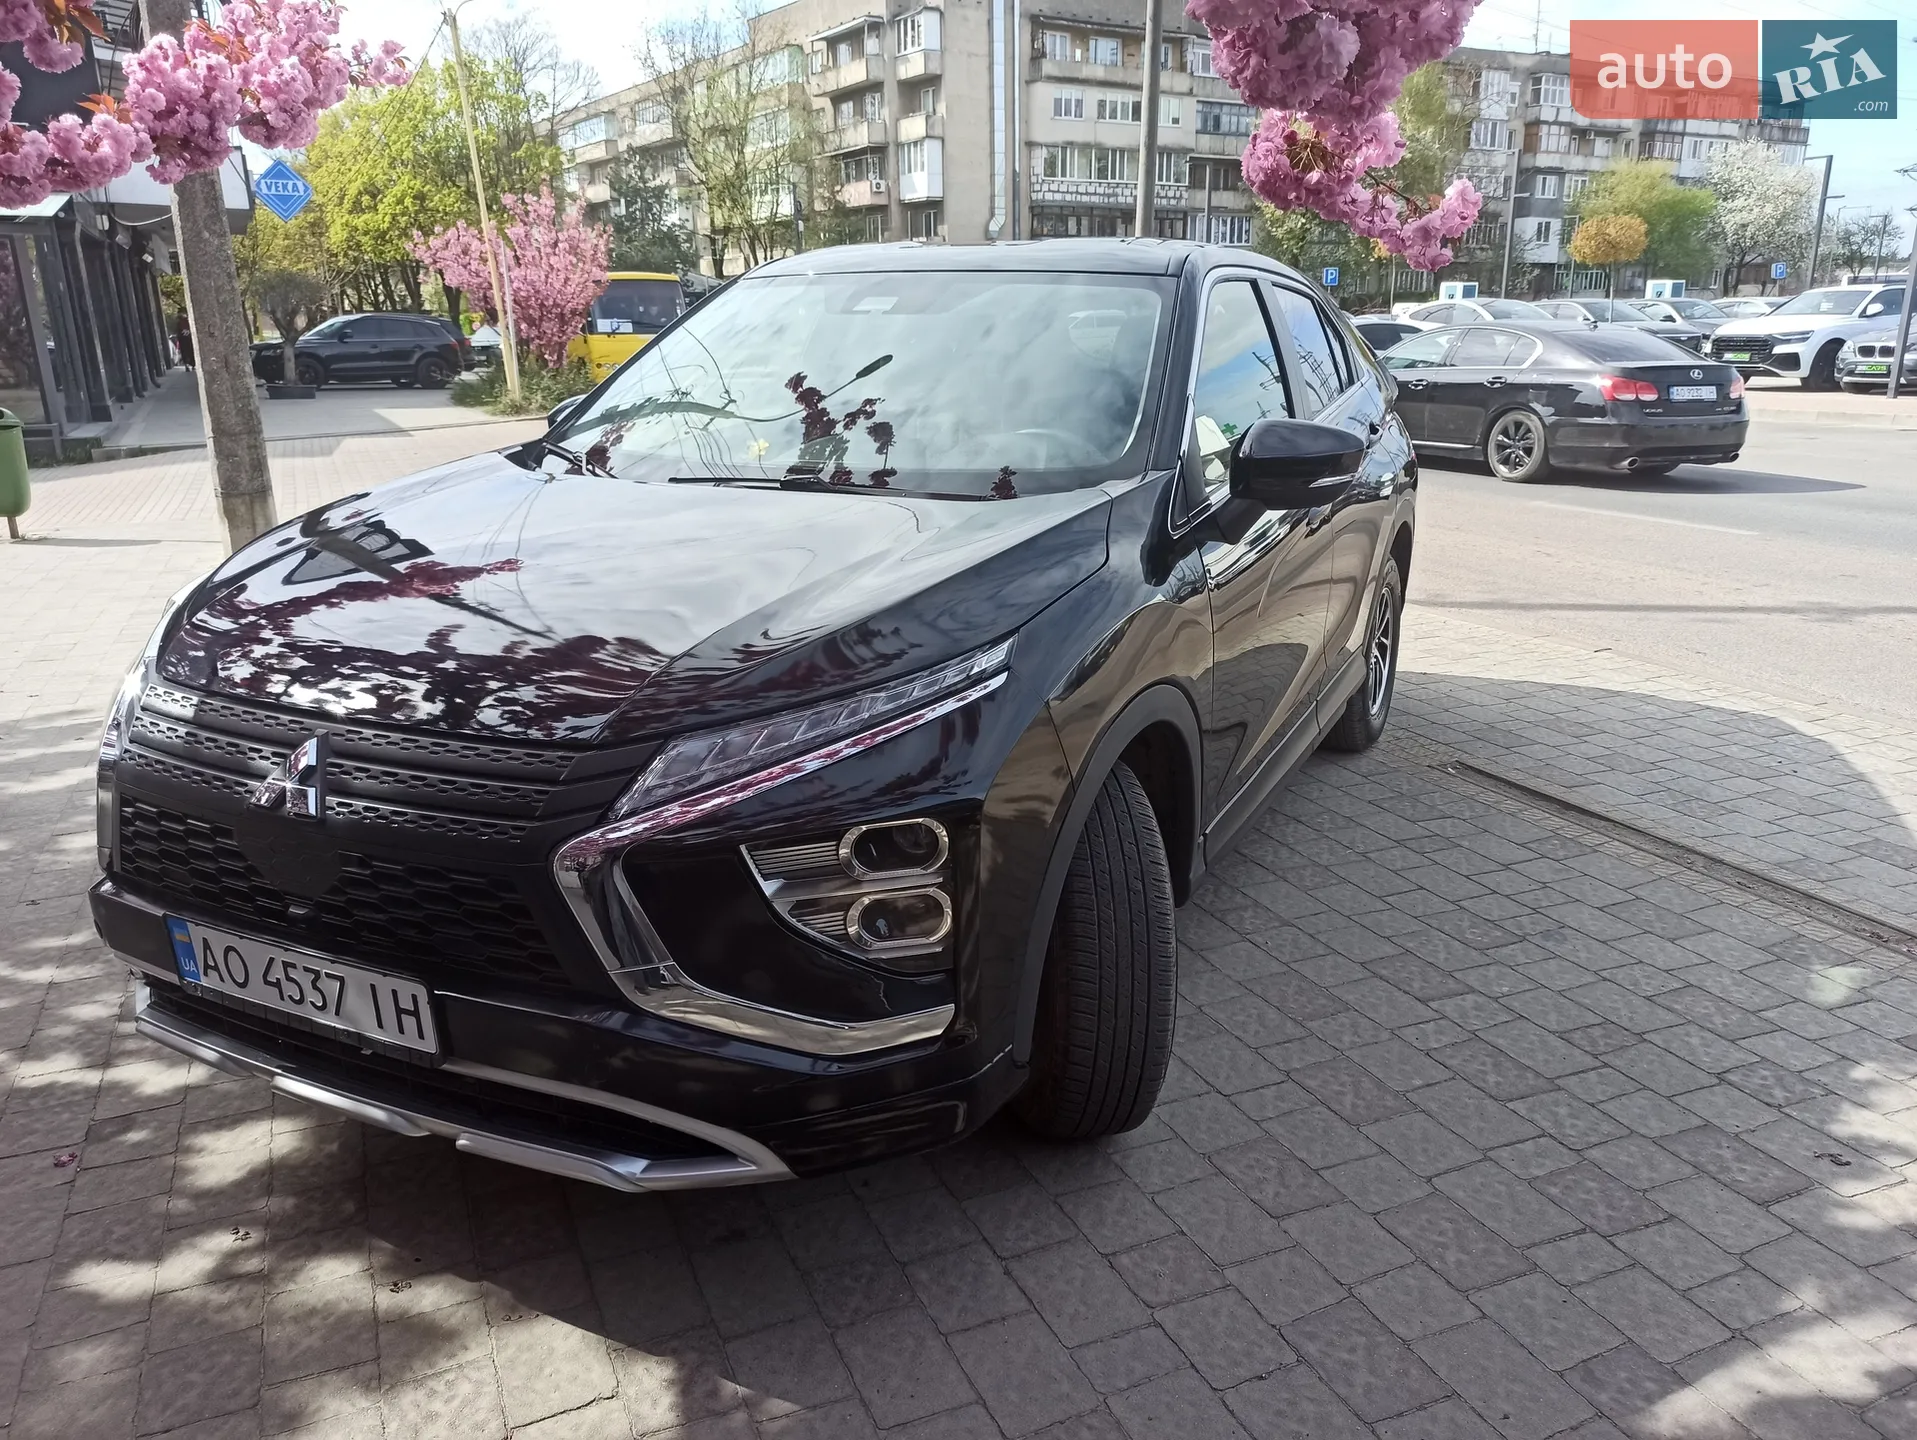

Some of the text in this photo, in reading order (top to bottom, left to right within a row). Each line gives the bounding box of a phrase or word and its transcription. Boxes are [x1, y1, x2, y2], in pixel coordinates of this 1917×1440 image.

[264, 180, 300, 194] VEKA
[1327, 269, 1336, 284] P
[1776, 264, 1784, 277] P
[181, 956, 198, 974] UA
[202, 936, 425, 1041] AO 4537 IH
